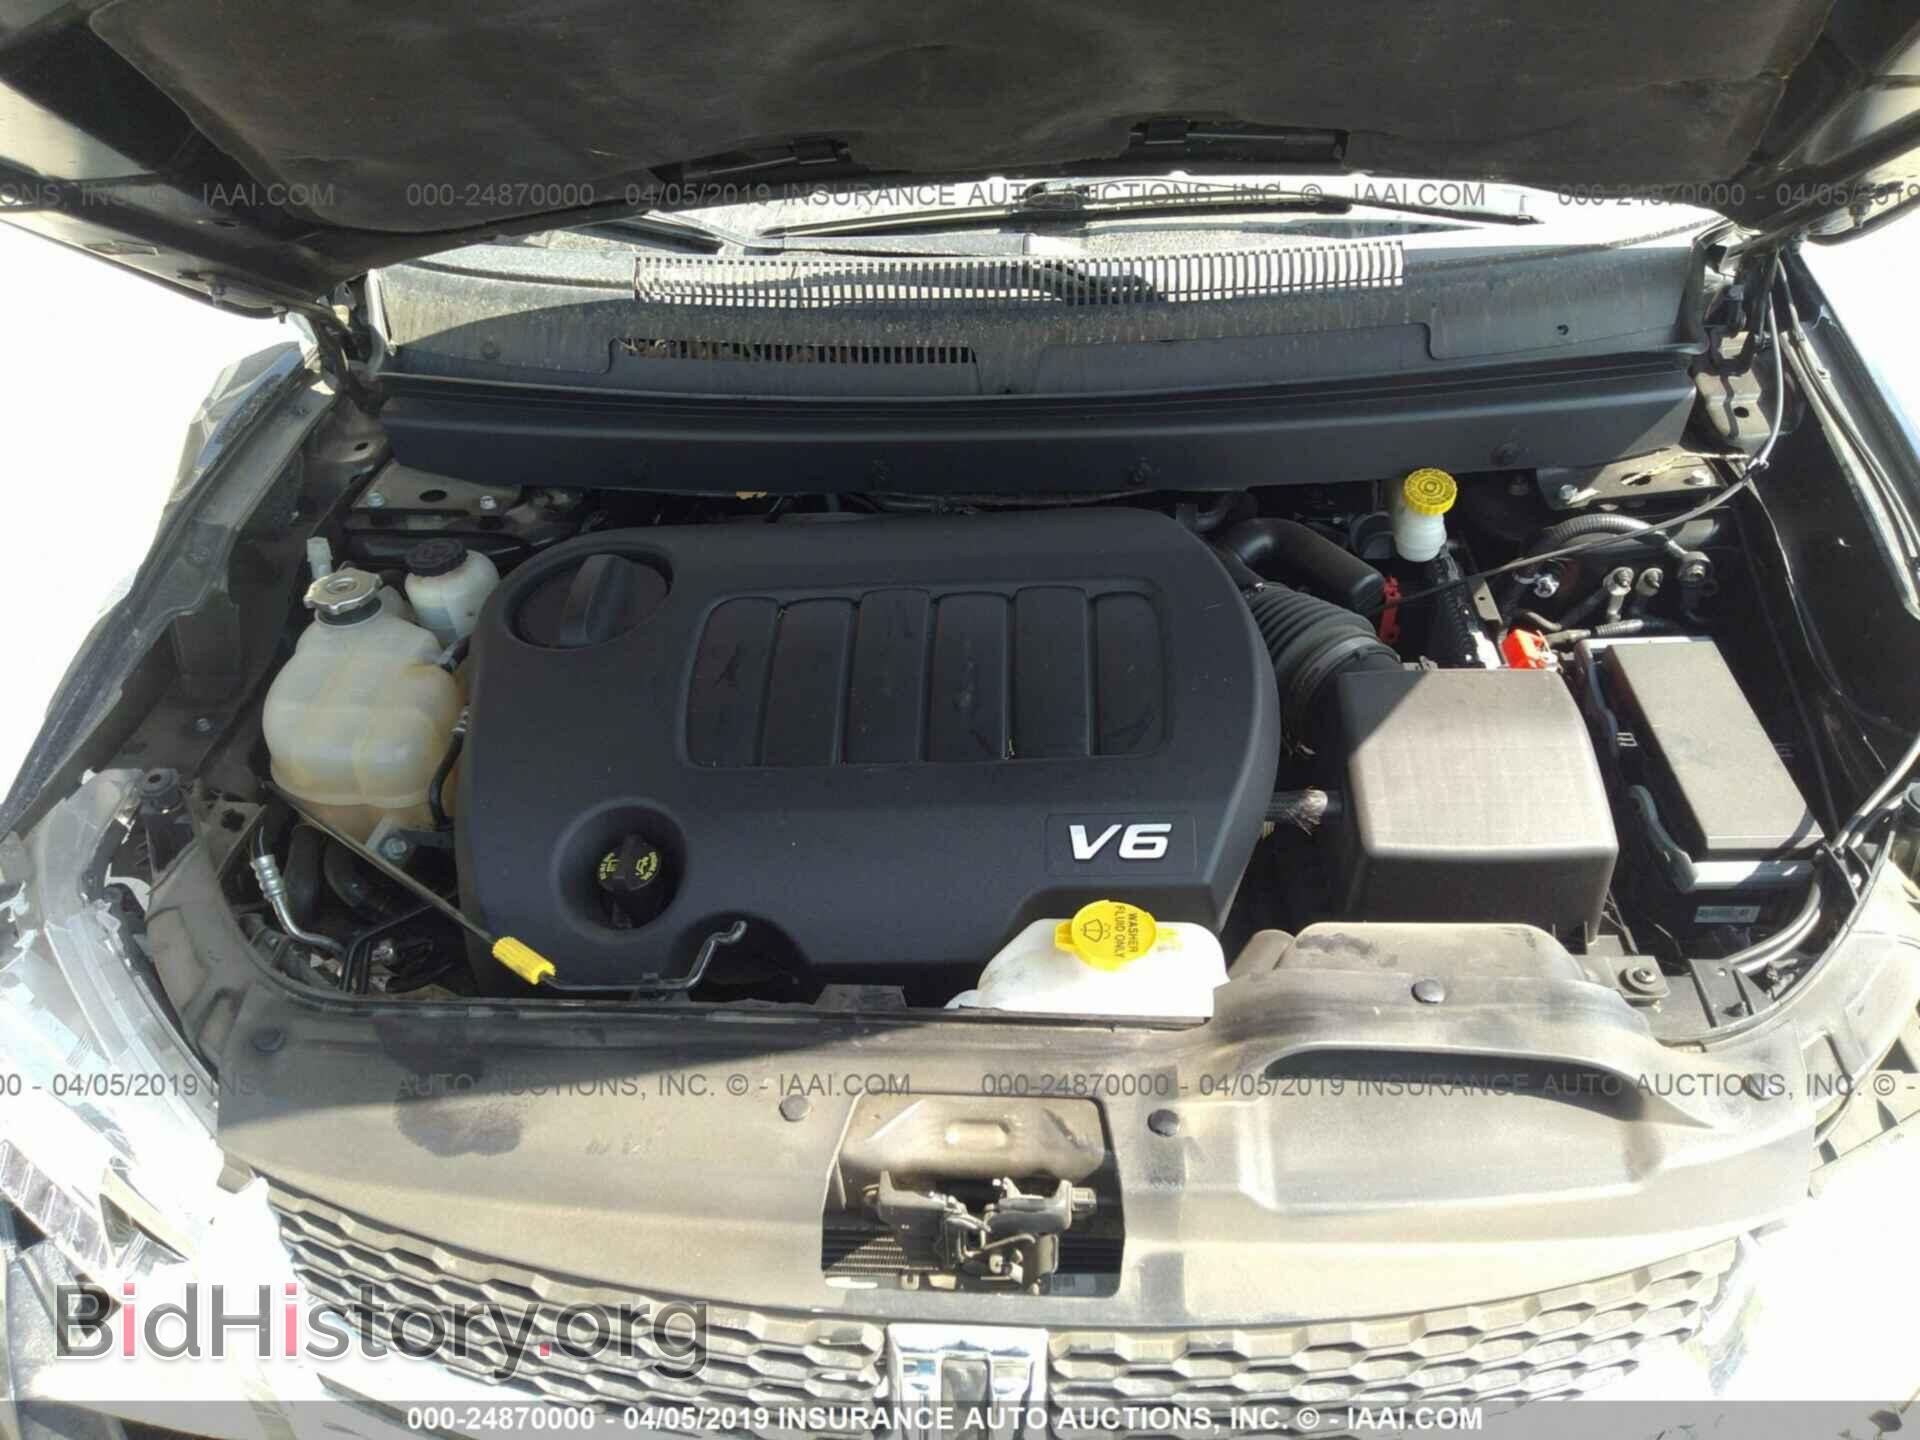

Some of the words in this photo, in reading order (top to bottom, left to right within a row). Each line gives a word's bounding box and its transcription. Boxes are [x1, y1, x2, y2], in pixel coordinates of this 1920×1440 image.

[1069, 824, 1172, 860] V6
[1114, 905, 1126, 932] FLUID
[1127, 912, 1139, 953] WASHER
[1114, 933, 1126, 958] ONLY
